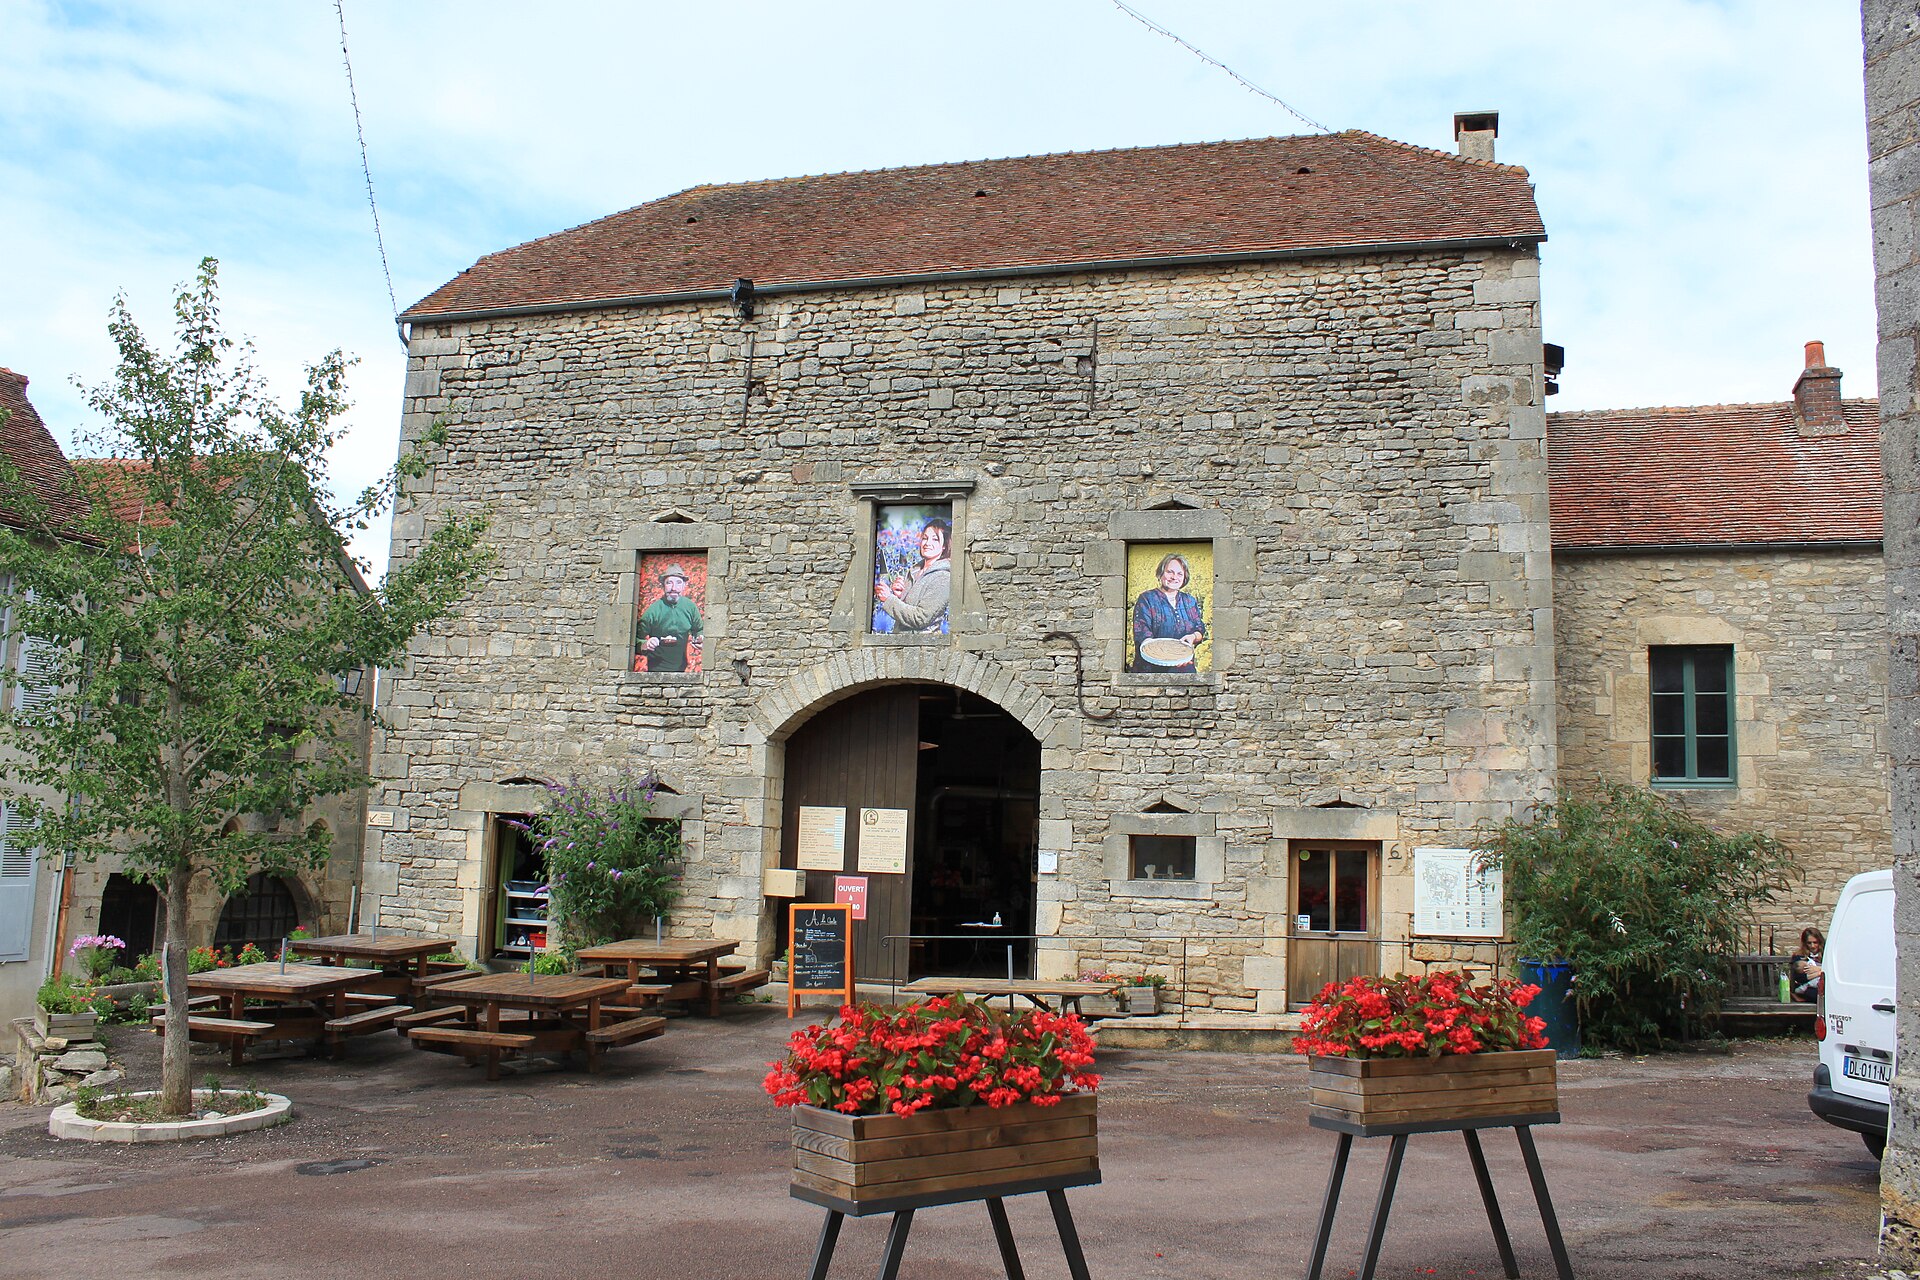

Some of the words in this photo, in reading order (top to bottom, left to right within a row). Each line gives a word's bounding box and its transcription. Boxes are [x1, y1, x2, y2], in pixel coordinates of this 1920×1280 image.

[1389, 843, 1401, 859] 6
[838, 885, 864, 893] OUVERT
[1829, 1013, 1852, 1022] PEUGEOT
